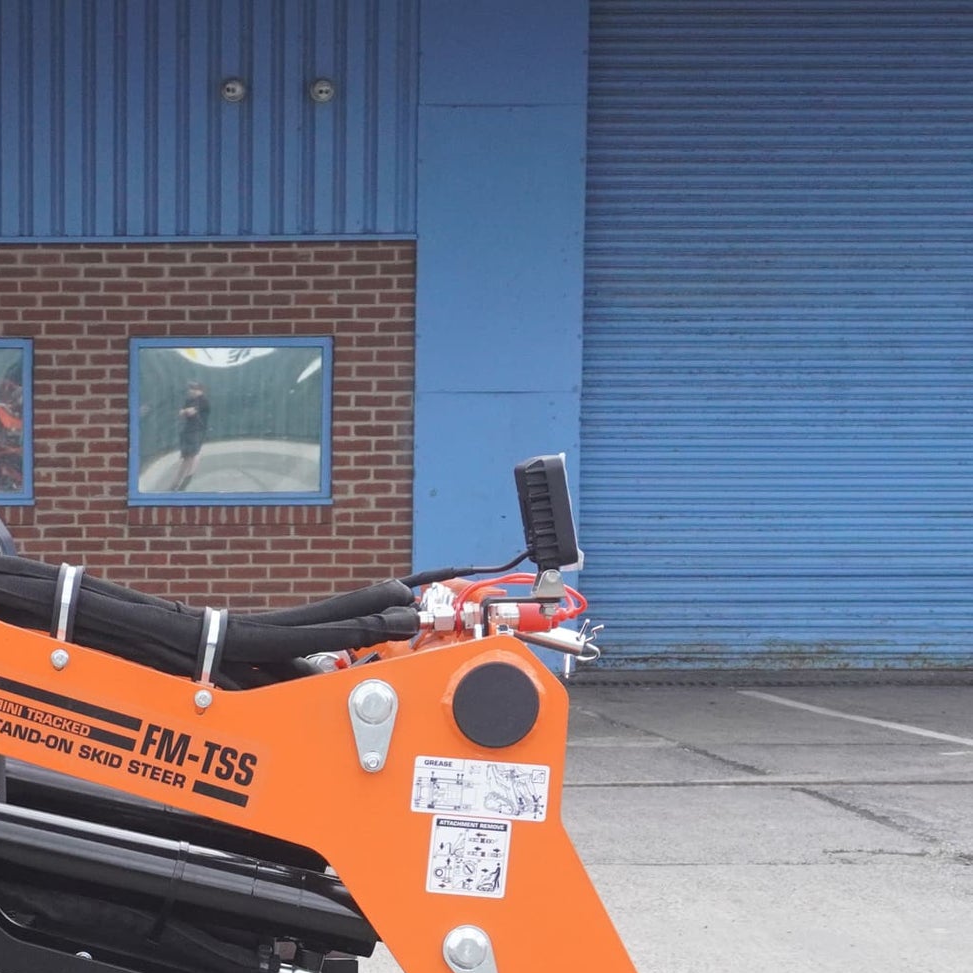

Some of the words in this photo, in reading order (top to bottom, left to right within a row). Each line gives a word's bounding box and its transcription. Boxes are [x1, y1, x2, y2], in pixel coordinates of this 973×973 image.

[27, 708, 91, 738] TRACKED
[78, 744, 123, 769] SKID
[127, 759, 187, 789] STEER
[140, 723, 258, 787] FM-TSS
[424, 759, 453, 768] GREASE
[438, 820, 478, 828] ATTACHMENT
